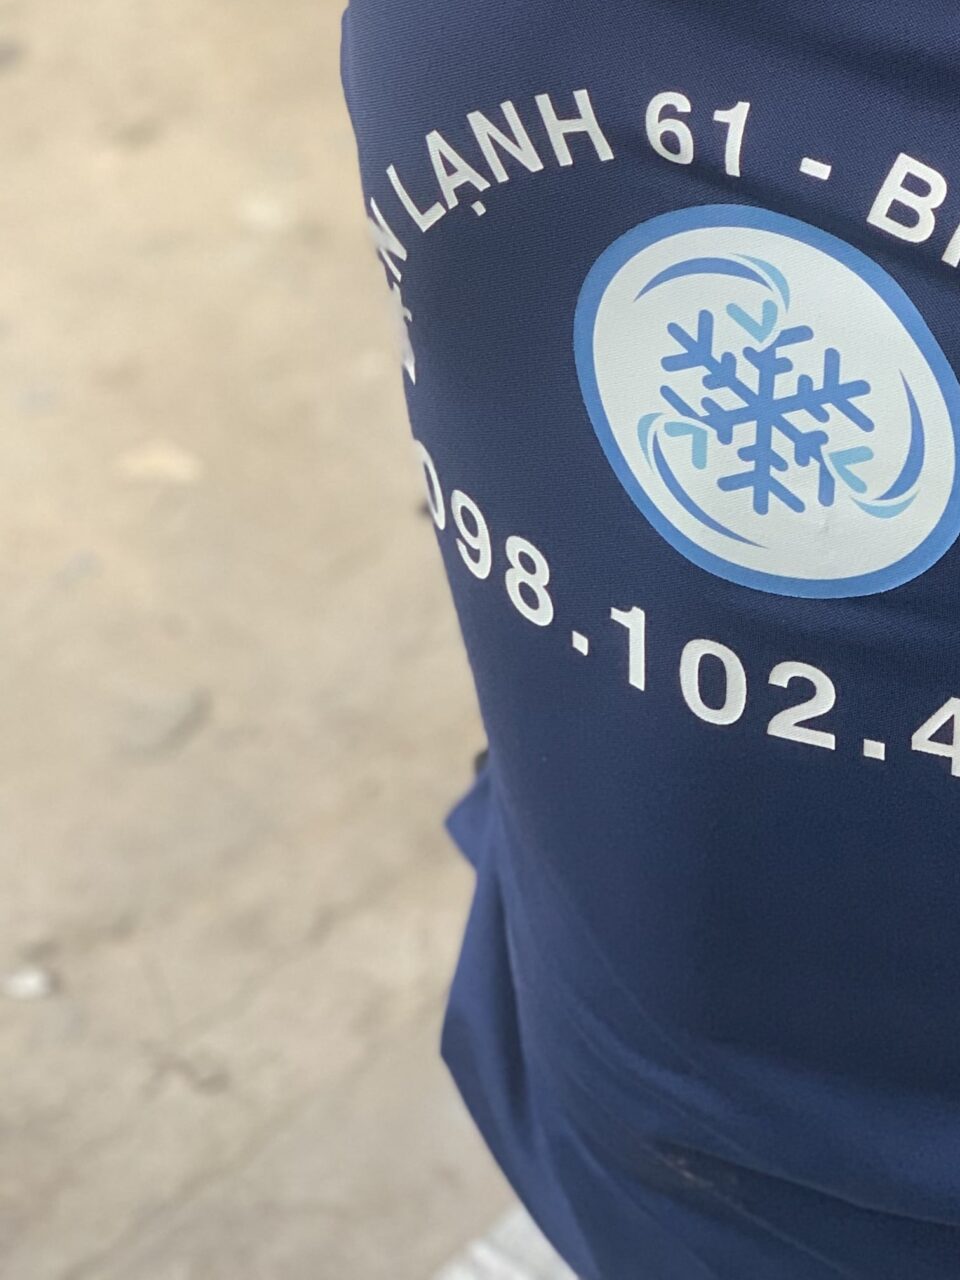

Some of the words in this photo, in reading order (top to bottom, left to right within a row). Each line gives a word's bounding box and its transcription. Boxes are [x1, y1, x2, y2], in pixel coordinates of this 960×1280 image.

[385, 88, 615, 233] LẠNH
[644, 90, 751, 178] 61
[799, 156, 833, 181] -
